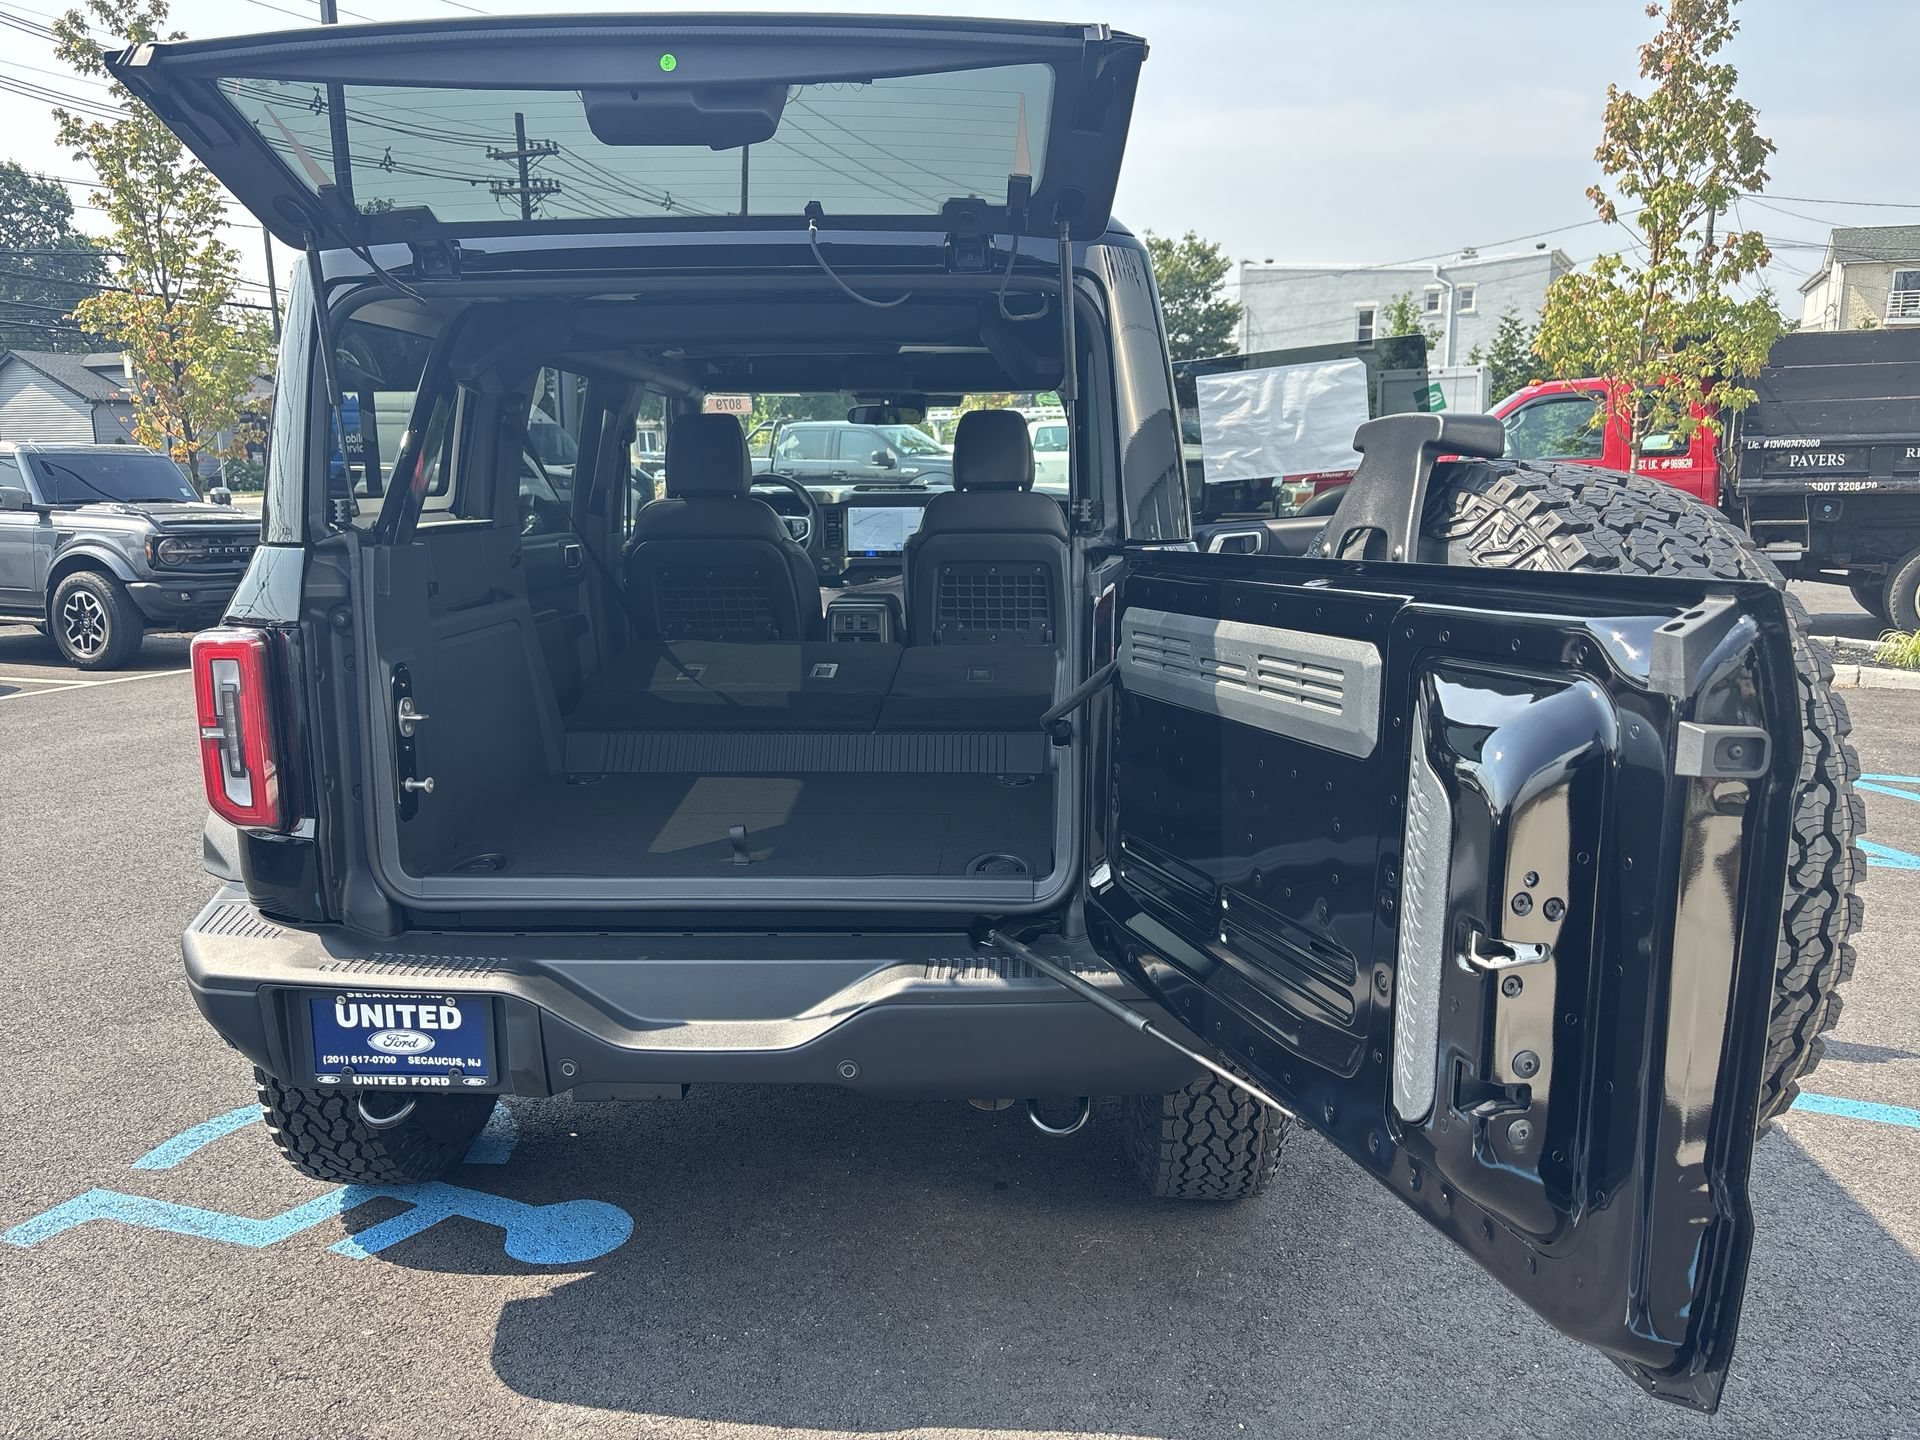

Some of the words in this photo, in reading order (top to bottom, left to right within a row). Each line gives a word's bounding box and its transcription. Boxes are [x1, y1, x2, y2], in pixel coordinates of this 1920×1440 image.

[338, 433, 363, 444] obil
[1789, 454, 1845, 467] PAVERS
[1804, 482, 1837, 492] SDOT
[335, 1004, 462, 1029] UNITED
[383, 1034, 419, 1048] Ford
[322, 1055, 349, 1065] (201)
[351, 1055, 397, 1065] 617-0700
[407, 1056, 466, 1067] SECAUCUS,
[468, 1058, 481, 1067] NJ
[352, 1076, 407, 1086] UNITED
[411, 1077, 450, 1087] FORD
